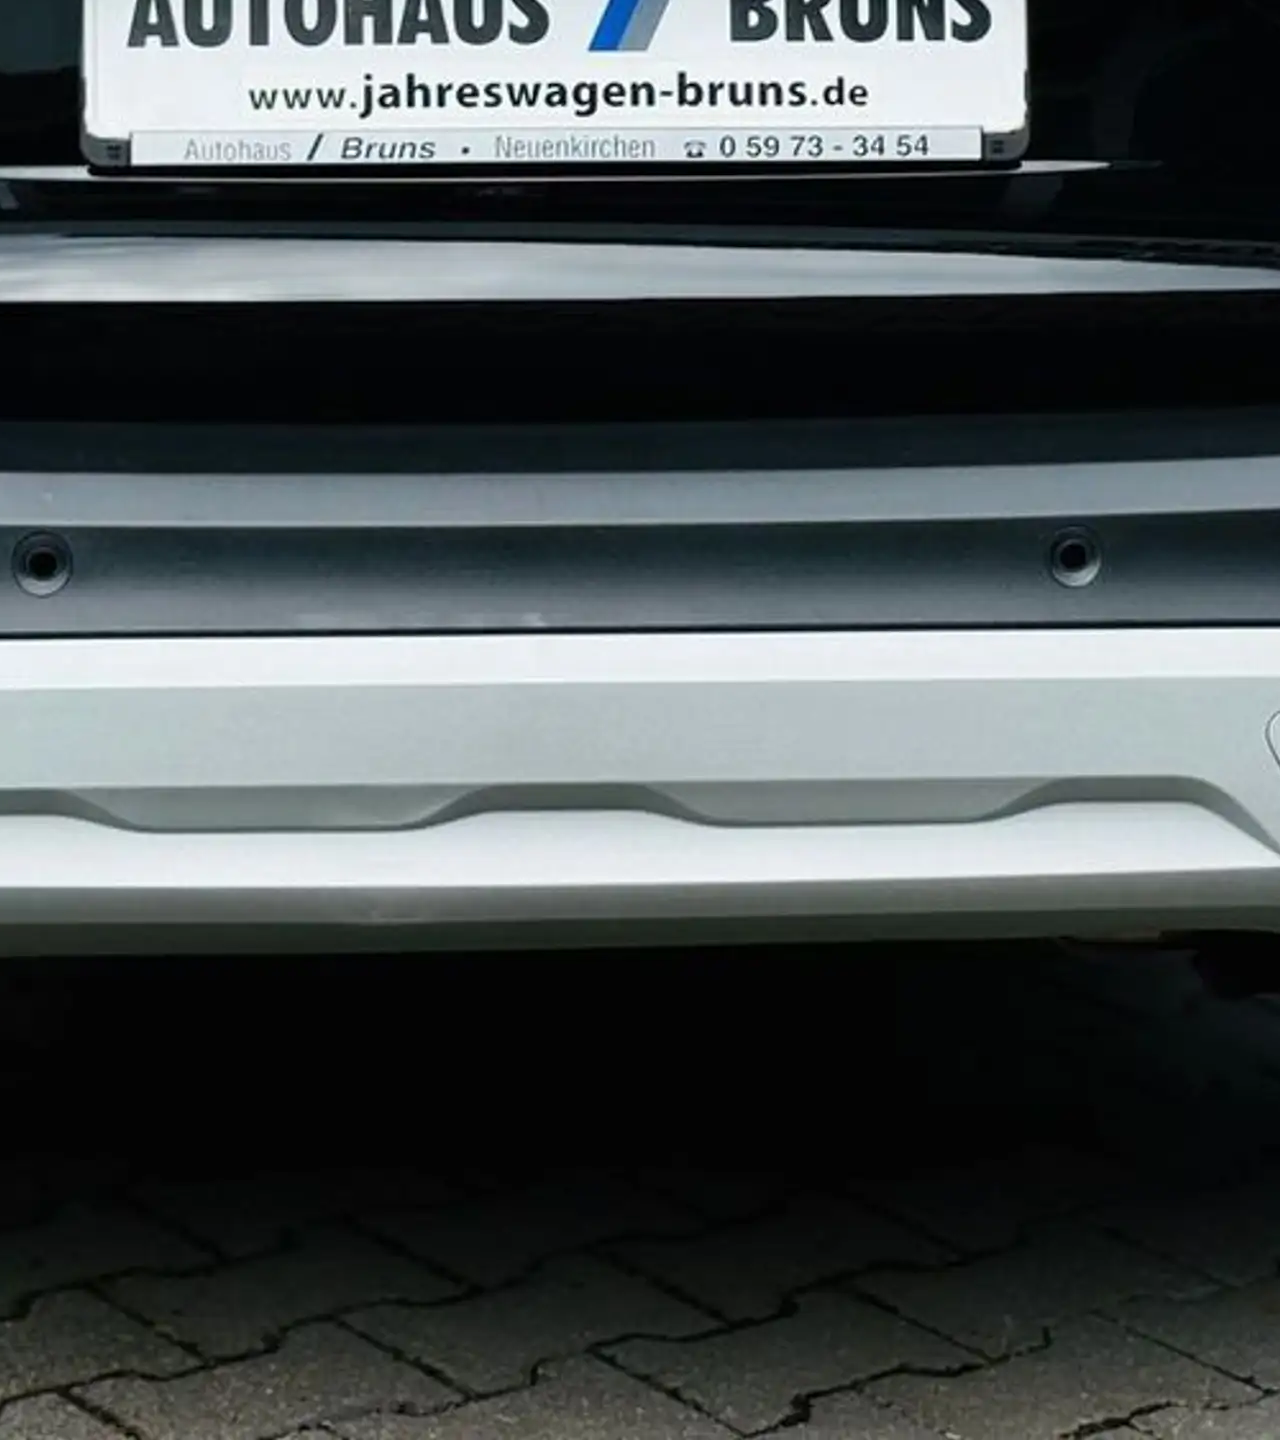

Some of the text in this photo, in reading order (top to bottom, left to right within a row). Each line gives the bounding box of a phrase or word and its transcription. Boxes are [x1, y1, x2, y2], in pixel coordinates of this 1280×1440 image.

[248, 71, 870, 119] www.jahreswagen-bruns.de
[183, 138, 292, 162] Autohaus
[339, 136, 438, 160] Bruns
[494, 134, 657, 160] Neuenkirchen
[718, 135, 737, 157] 0
[745, 135, 781, 157] 59
[790, 135, 825, 157] 73
[852, 134, 886, 156] 34
[895, 134, 931, 156] 54
